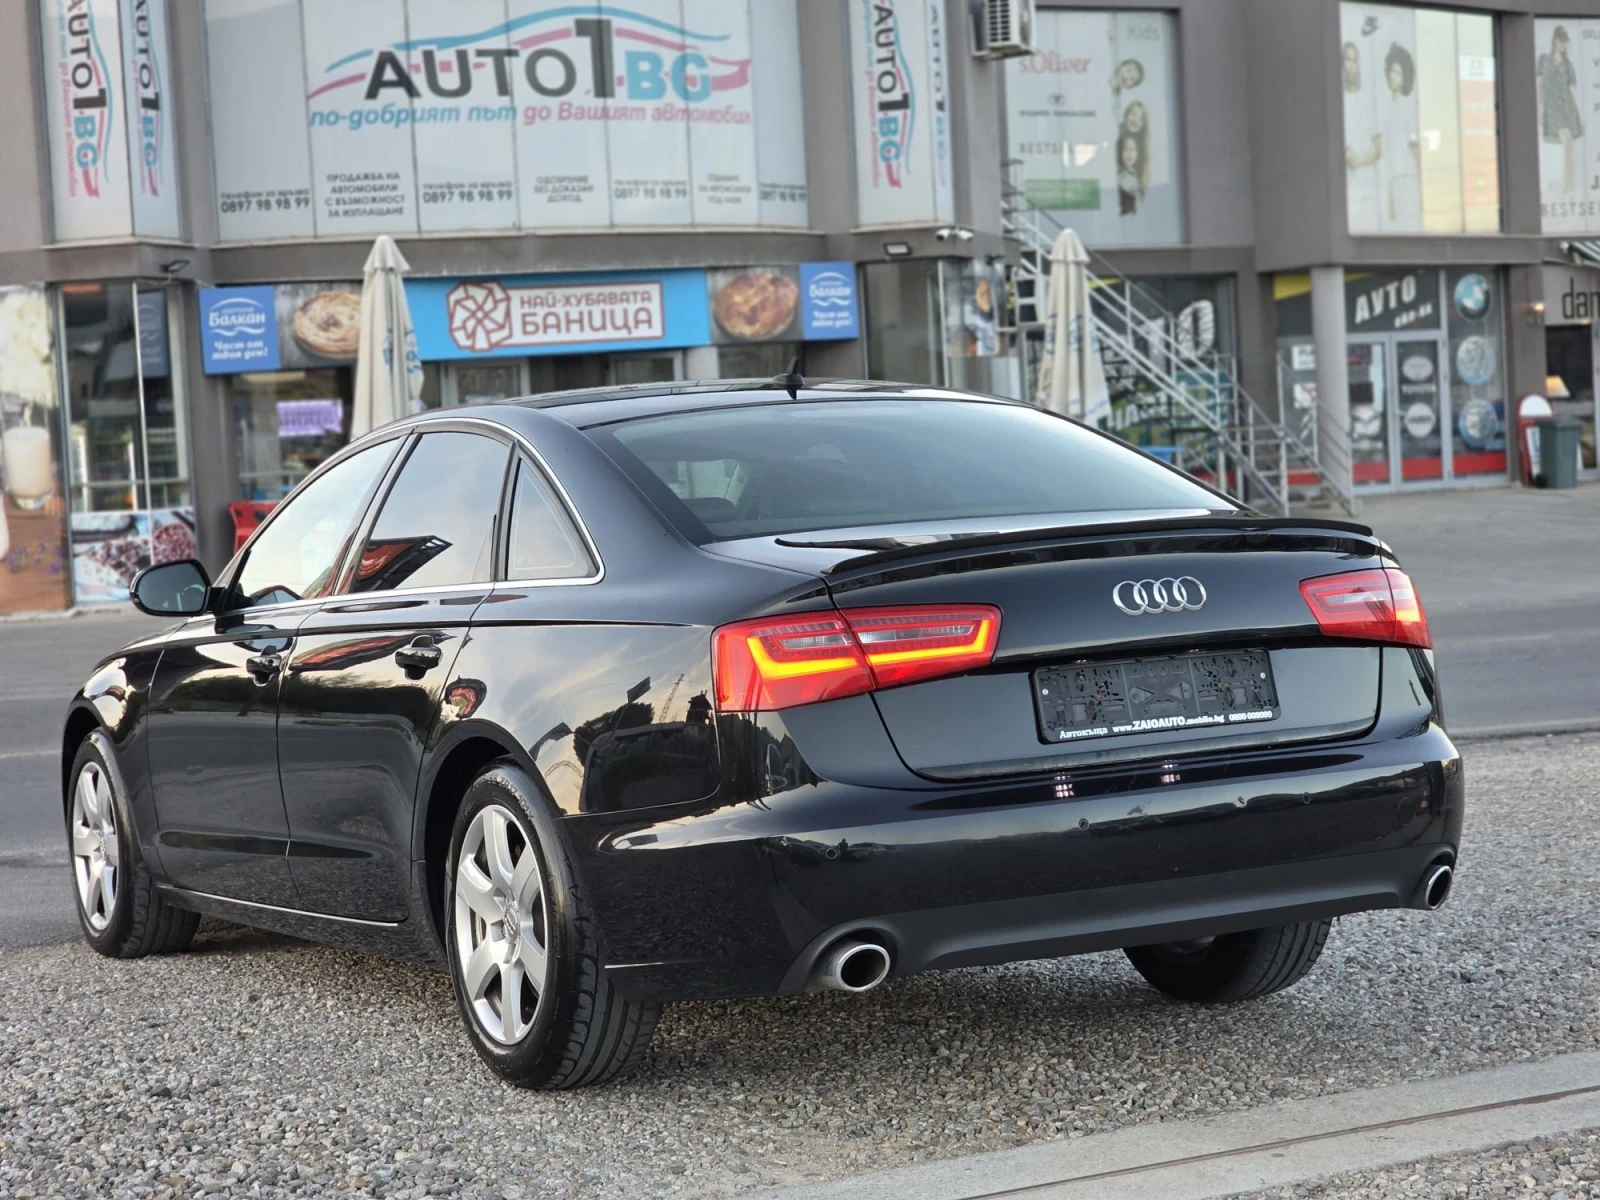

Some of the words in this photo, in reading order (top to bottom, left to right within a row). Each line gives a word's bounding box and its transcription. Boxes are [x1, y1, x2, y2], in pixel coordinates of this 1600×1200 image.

[310, 103, 461, 130] по-добрият
[467, 105, 518, 122] път
[523, 105, 552, 126] до
[557, 101, 646, 121] Вашият
[220, 200, 253, 213] 0897
[256, 198, 272, 211] 98
[275, 197, 292, 210] 98
[295, 195, 311, 209] 99
[423, 190, 455, 204] 0897
[458, 189, 475, 203] 98
[498, 188, 513, 202] 99
[520, 290, 653, 310] НАЙ-ХУБАВАТА
[208, 311, 267, 328] Балкан
[520, 306, 654, 336] БАНИЦА
[1059, 726, 1108, 739] Автокъща
